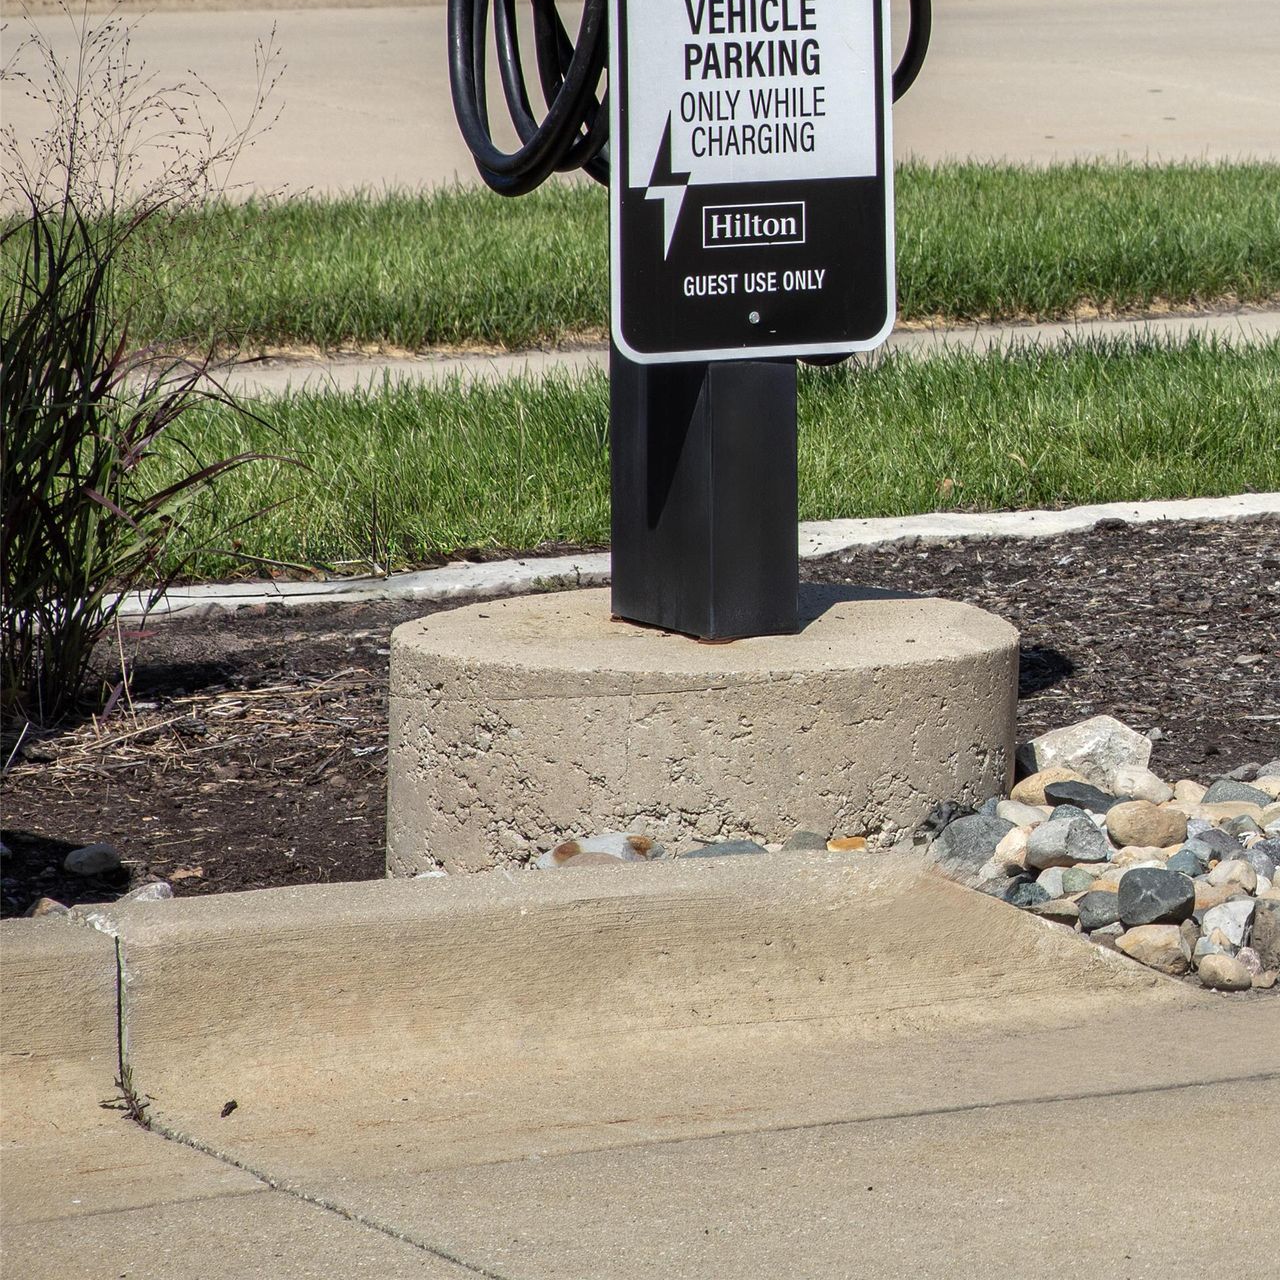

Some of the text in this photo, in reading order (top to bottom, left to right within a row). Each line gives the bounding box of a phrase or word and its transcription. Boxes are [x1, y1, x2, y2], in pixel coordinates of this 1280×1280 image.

[684, 38, 821, 81] PARKING
[680, 86, 826, 123] ONLY WHILE
[691, 121, 816, 158] CHARGING
[711, 210, 797, 240] Hilton
[683, 269, 826, 297] GUEST USE ONLY
